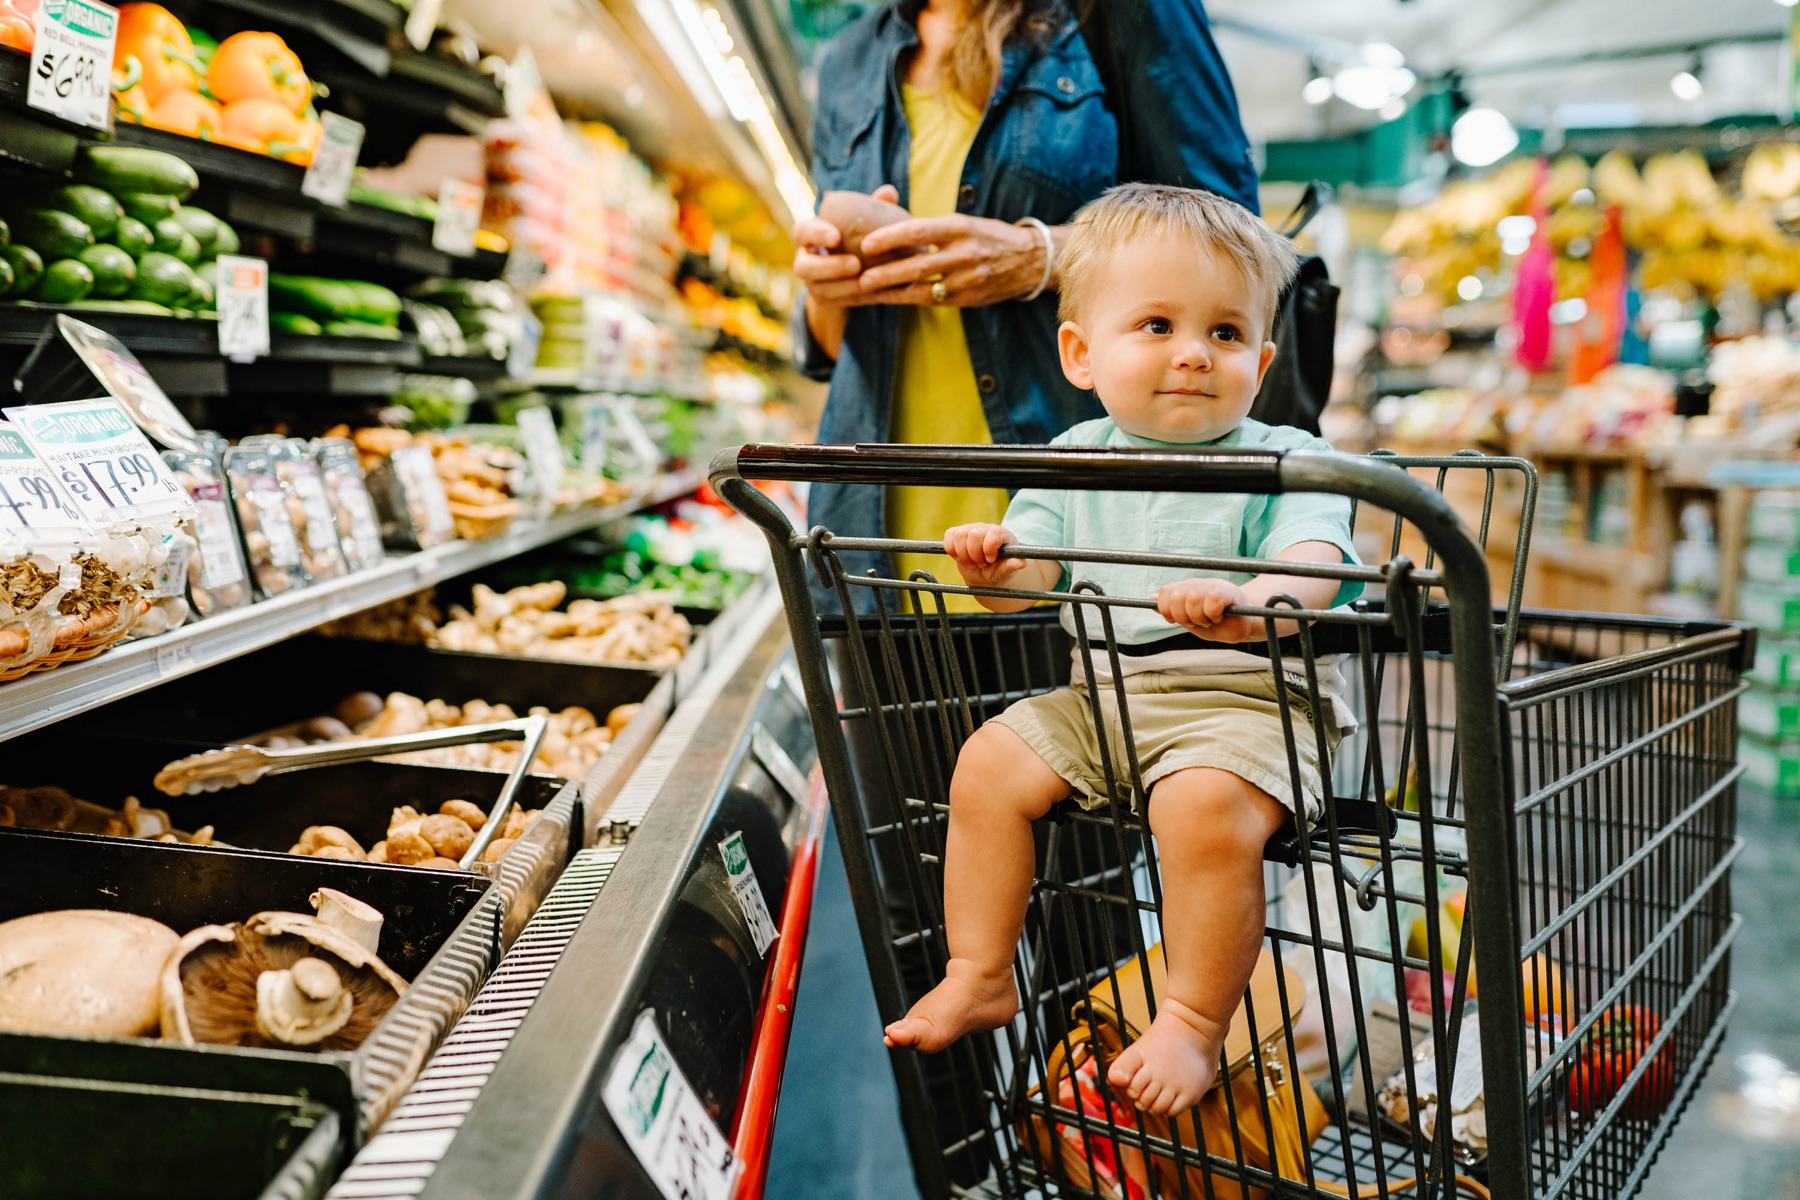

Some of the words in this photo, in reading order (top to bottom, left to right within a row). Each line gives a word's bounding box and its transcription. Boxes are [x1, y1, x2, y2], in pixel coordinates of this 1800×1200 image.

[58, 410, 129, 436] ORGANIC
[48, 449, 92, 463] MAITAKE
[93, 442, 149, 458] MUSHROOMS
[59, 454, 158, 508] $17.99
[161, 478, 178, 493] lb
